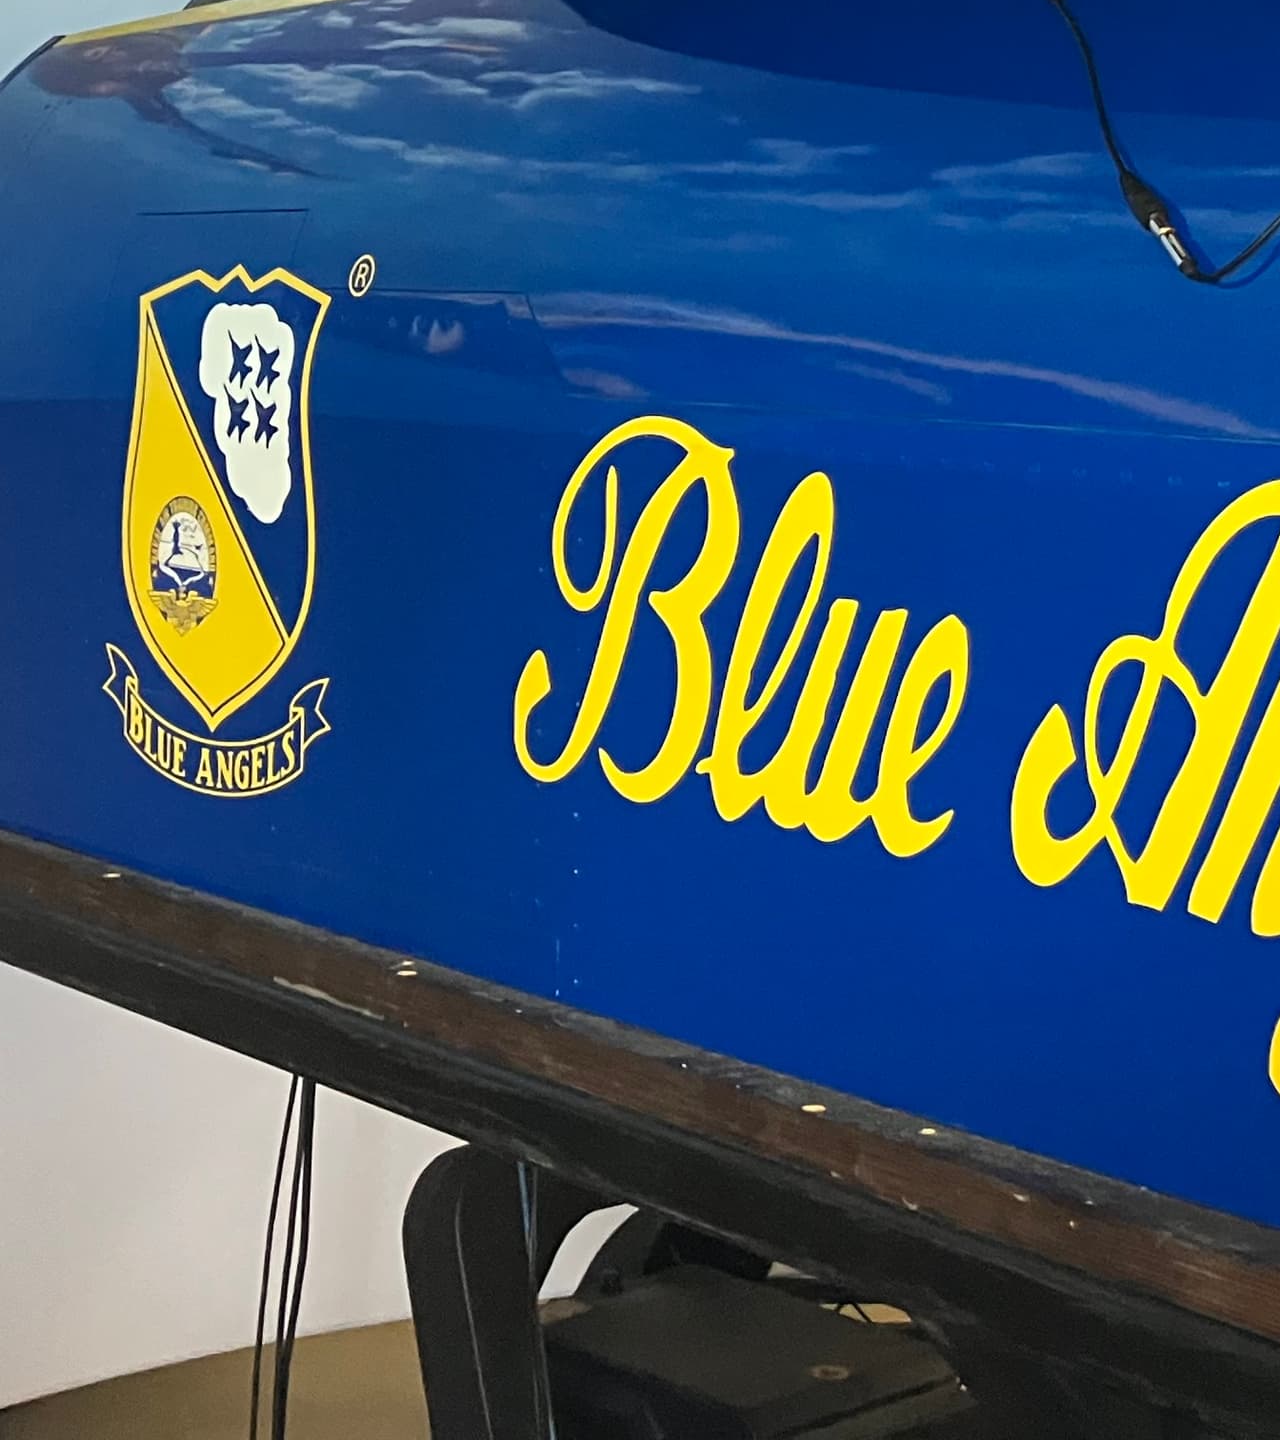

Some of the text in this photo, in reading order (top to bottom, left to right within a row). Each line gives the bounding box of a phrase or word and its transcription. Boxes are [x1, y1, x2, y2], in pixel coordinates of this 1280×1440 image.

[128, 704, 296, 790] BLUE ANGELS
[516, 417, 969, 857] Blue
